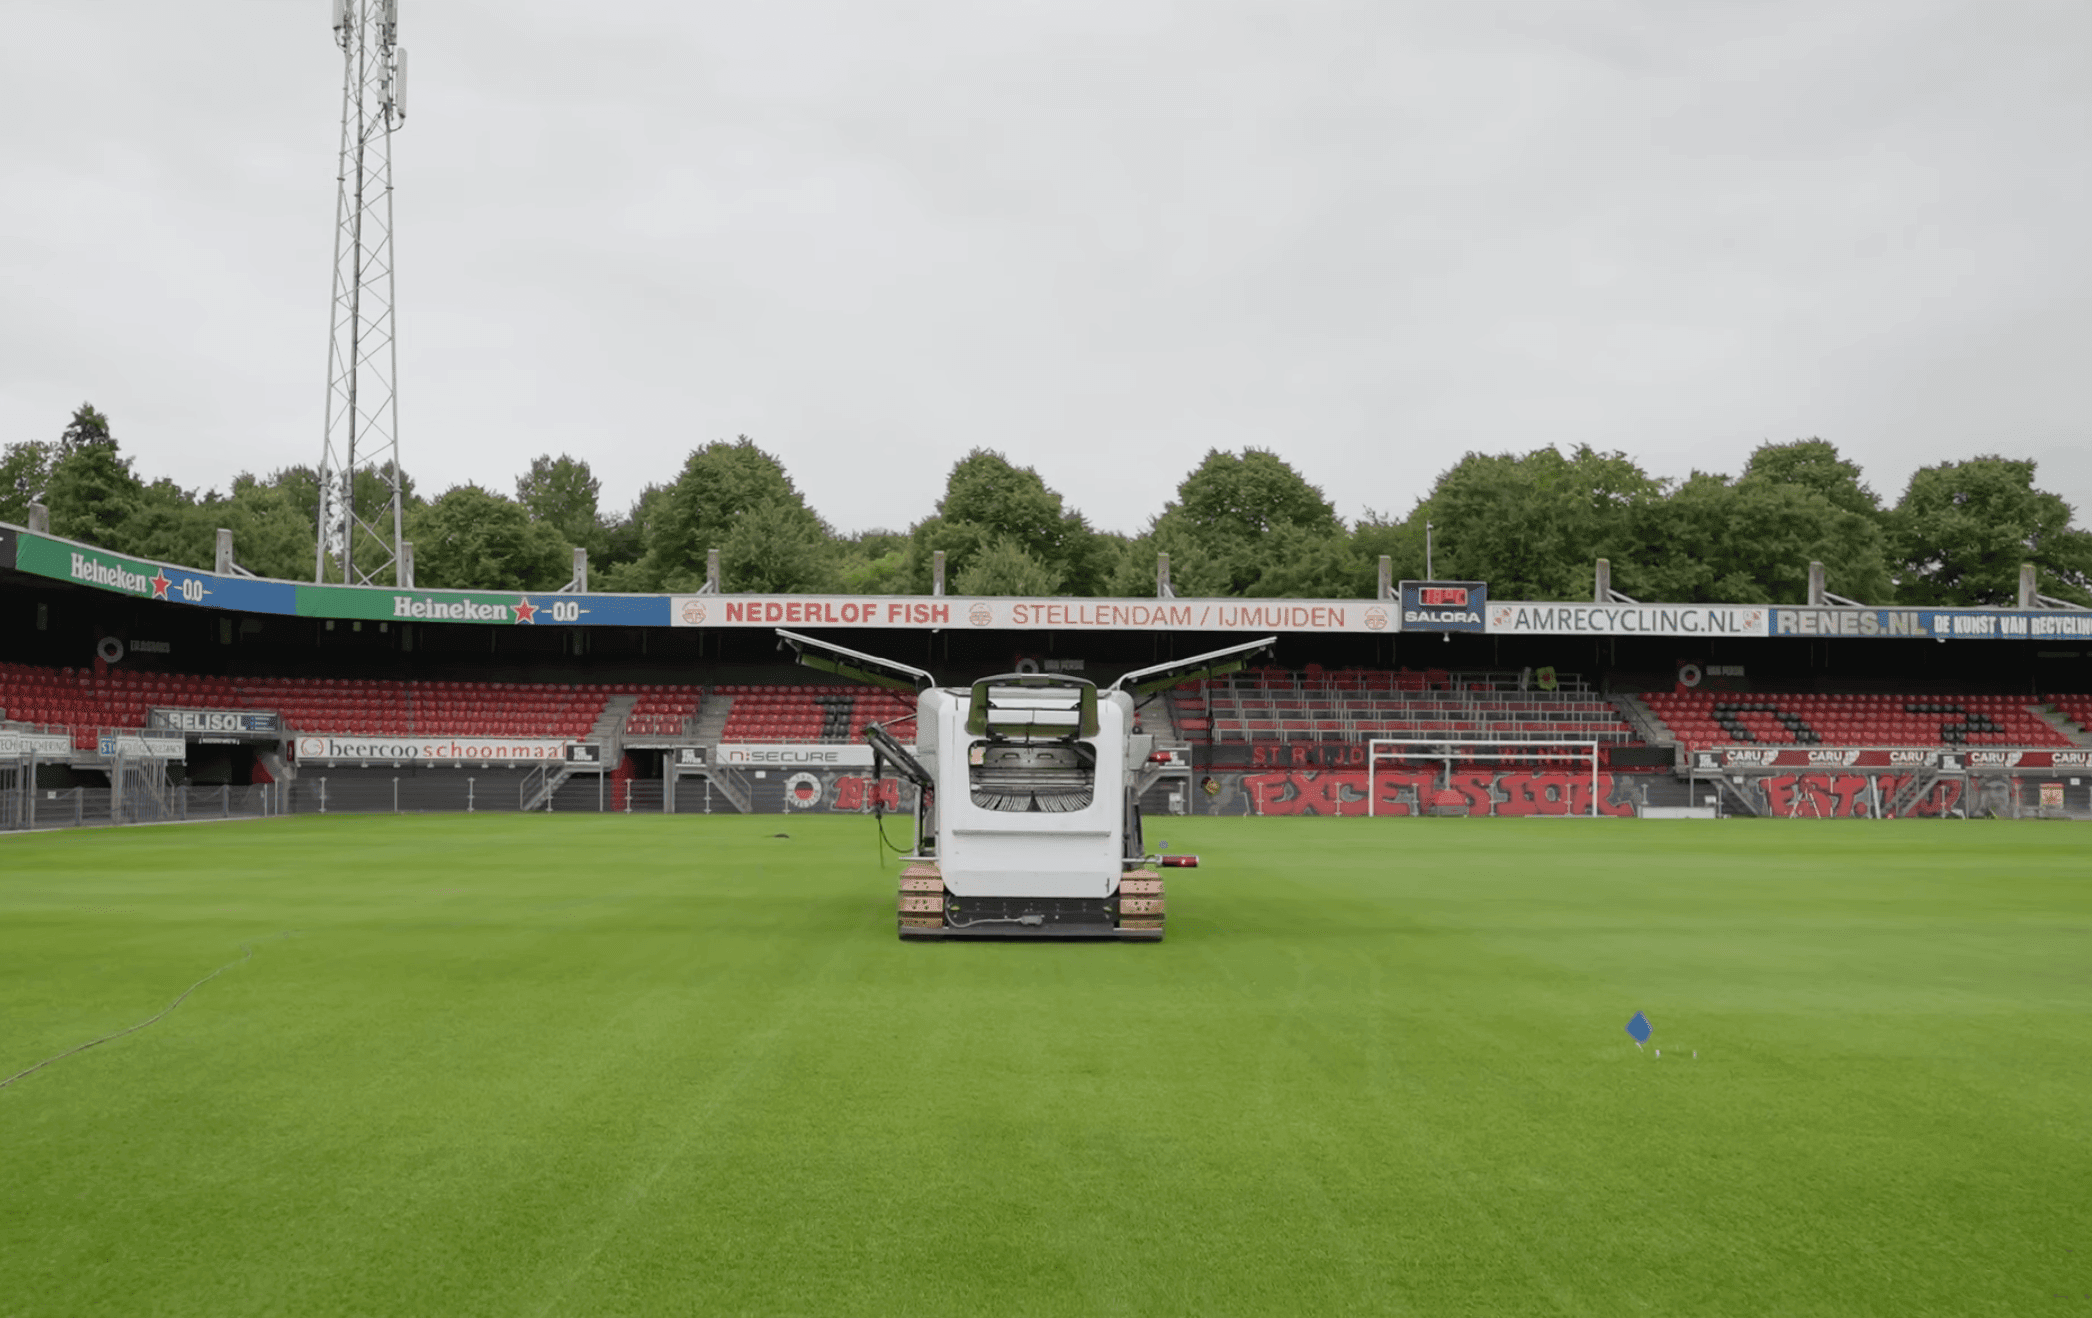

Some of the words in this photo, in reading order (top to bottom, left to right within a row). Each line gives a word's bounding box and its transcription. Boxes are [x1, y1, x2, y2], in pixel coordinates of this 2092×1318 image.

[71, 553, 147, 592] Heineken
[393, 596, 508, 620] Heineken
[726, 602, 878, 622] NEDERLOF
[887, 604, 949, 623] FISH
[1012, 604, 1191, 625] STELLENDAM
[1219, 606, 1345, 627] IJMUIDEN
[1405, 611, 1481, 623] SALORA
[1514, 608, 1741, 632] AMRECYCLING.NL
[1776, 611, 1927, 635] RENES.NL
[1934, 615, 1950, 633] DE
[1954, 615, 1996, 634] KUNST
[2001, 616, 2027, 634] VAN
[169, 713, 246, 730] BELISOL
[330, 740, 417, 757] beercoo
[1727, 750, 1761, 761] CARU
[1808, 750, 1842, 761] CARU
[1890, 751, 1924, 762] CARU
[1971, 752, 2005, 763] CARU
[2052, 752, 2086, 763] CARU
[1243, 773, 1635, 817] EXCELSIOR
